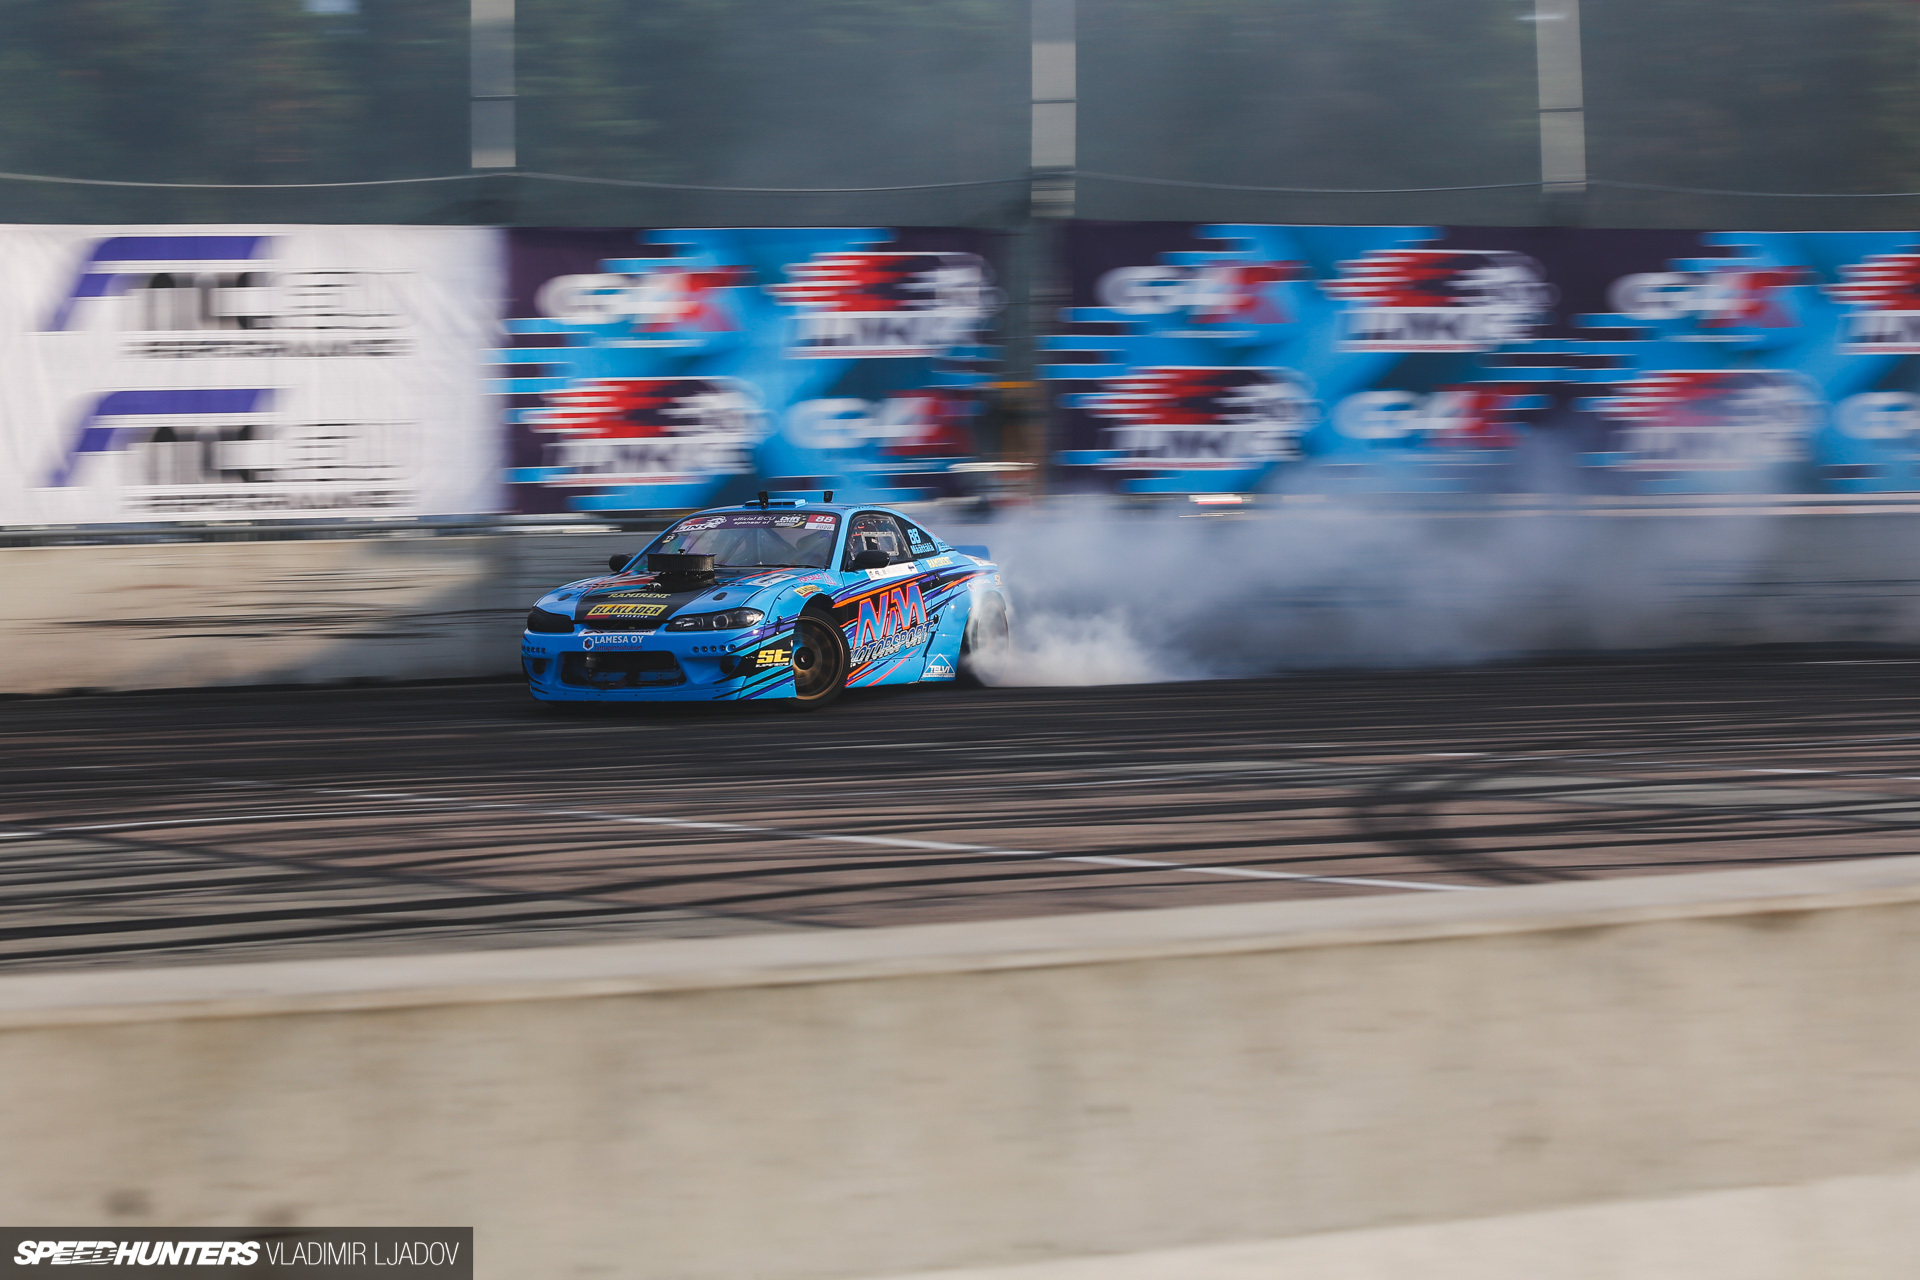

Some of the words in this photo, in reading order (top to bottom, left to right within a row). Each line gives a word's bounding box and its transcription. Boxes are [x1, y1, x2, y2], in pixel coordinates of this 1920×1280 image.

[907, 528, 921, 544] 88
[591, 604, 662, 615] BLÅKLÄDER
[595, 635, 629, 644] LAMESA
[630, 635, 644, 643] OY
